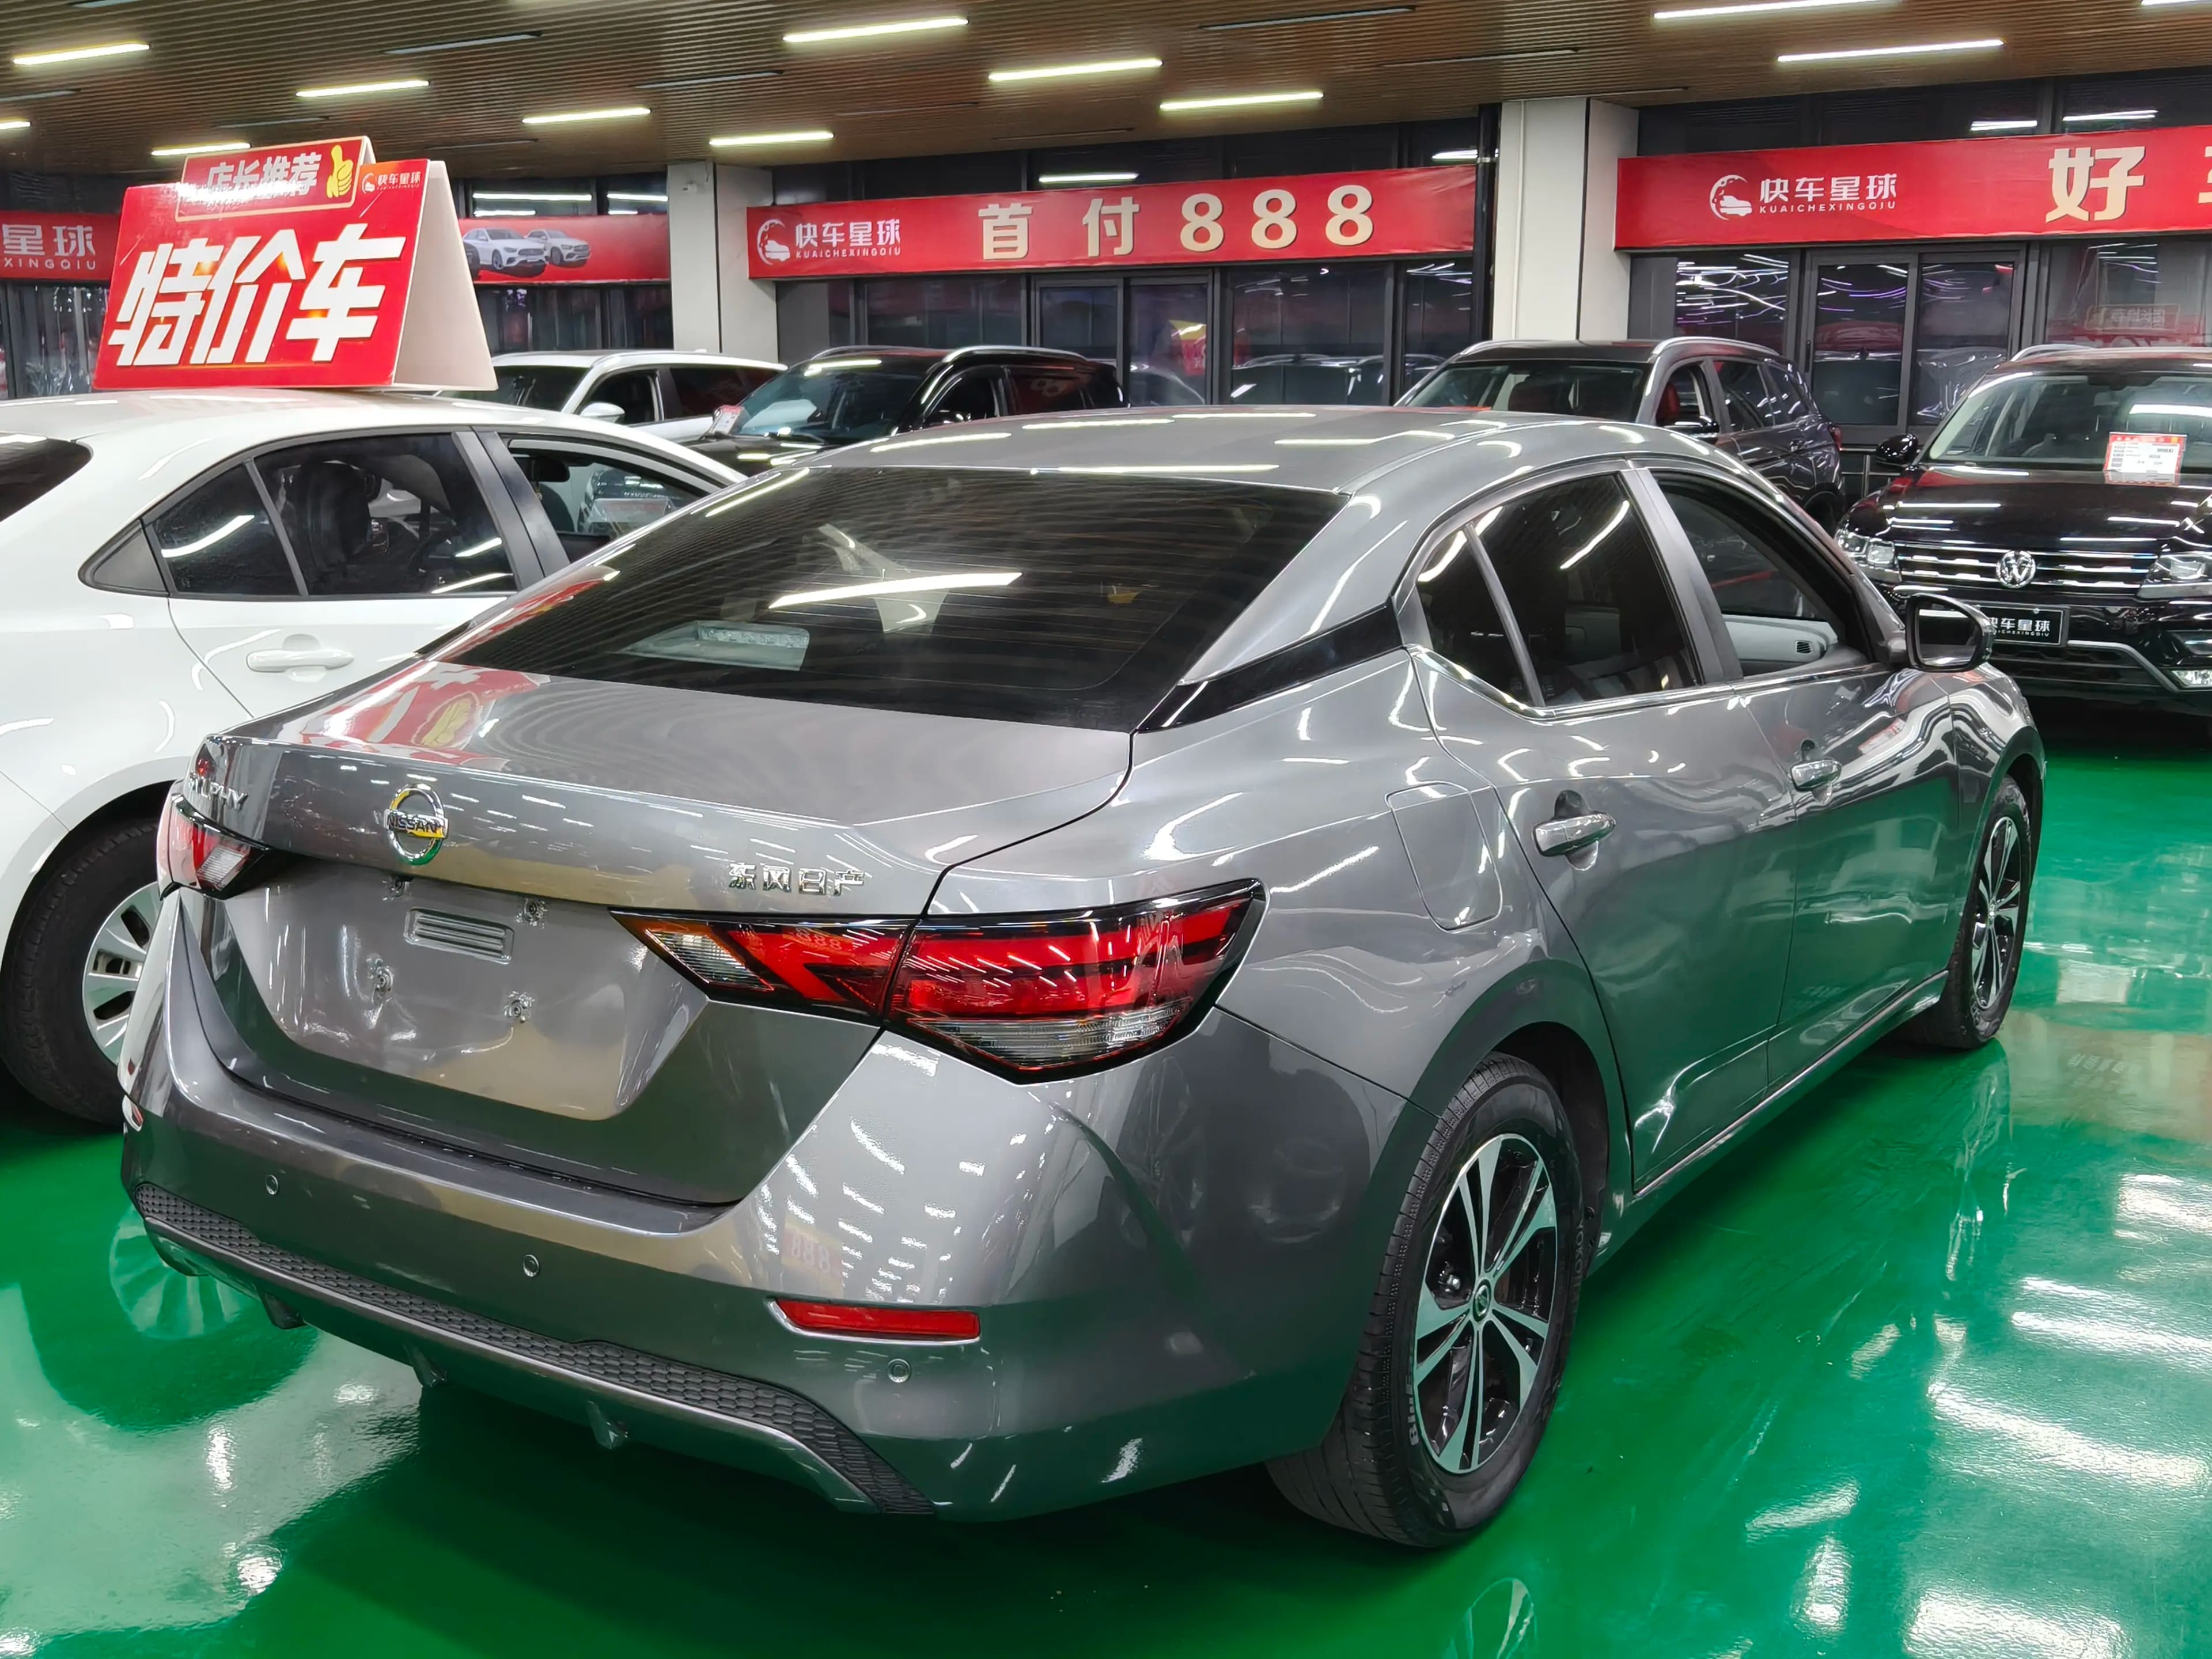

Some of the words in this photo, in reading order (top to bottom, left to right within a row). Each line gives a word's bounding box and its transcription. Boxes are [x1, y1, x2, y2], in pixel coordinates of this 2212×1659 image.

[1759, 173, 1897, 203] 快车星球
[2046, 146, 2212, 222] 好
[2, 224, 96, 257] 星球
[796, 218, 900, 248] 快车星球
[108, 223, 406, 366] 特价车
[387, 810, 444, 837] NISSAN
[729, 862, 864, 896] 东风日产
